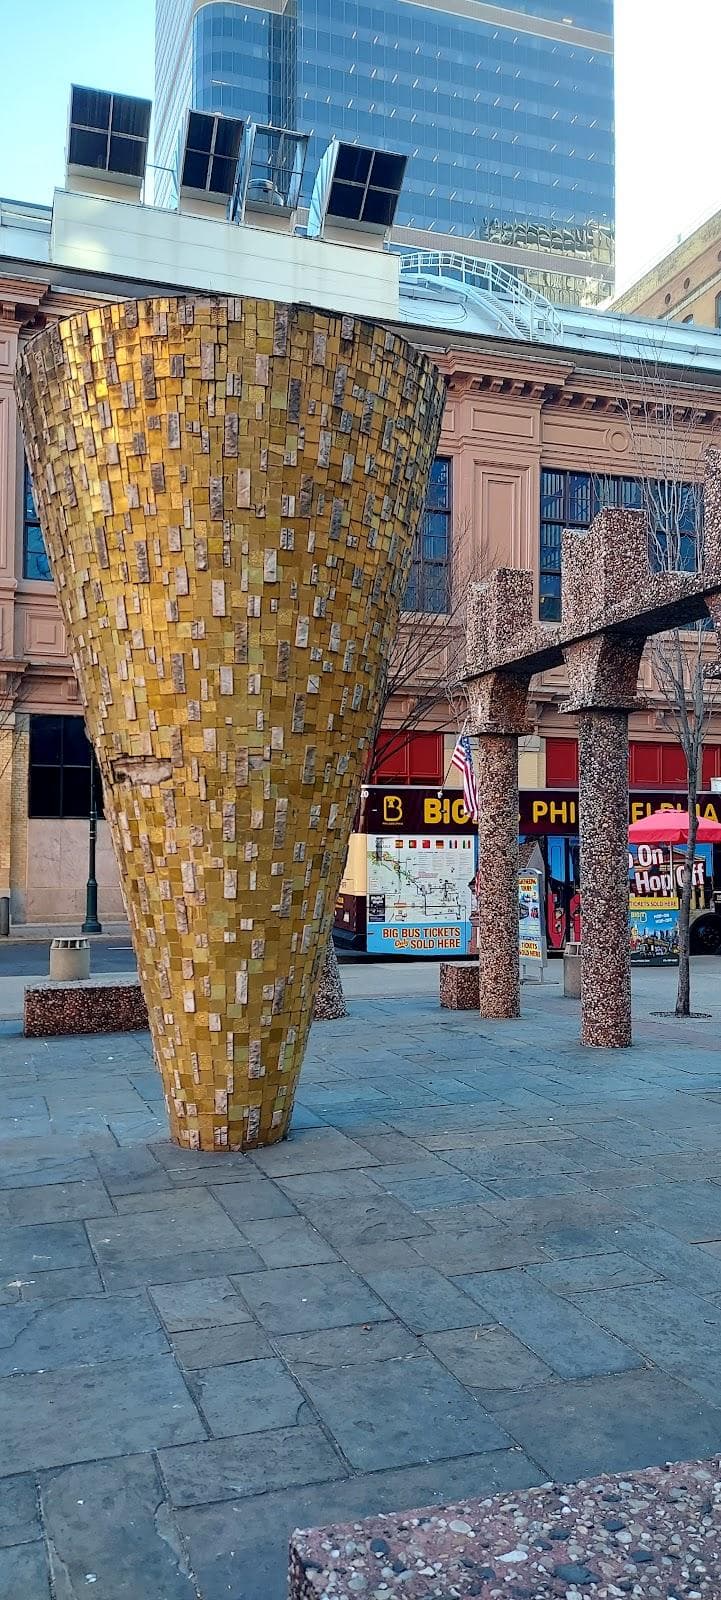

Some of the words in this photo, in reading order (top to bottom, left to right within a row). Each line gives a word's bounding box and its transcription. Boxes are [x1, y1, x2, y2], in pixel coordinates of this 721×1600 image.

[424, 798, 470, 824] BIG
[638, 845, 664, 867] On
[635, 871, 672, 897] Hop
[383, 928, 398, 938] BIG
[401, 928, 420, 938] BUS
[423, 927, 461, 938] TICKETS
[411, 940, 434, 949] SOLD
[437, 938, 461, 948] HERE
